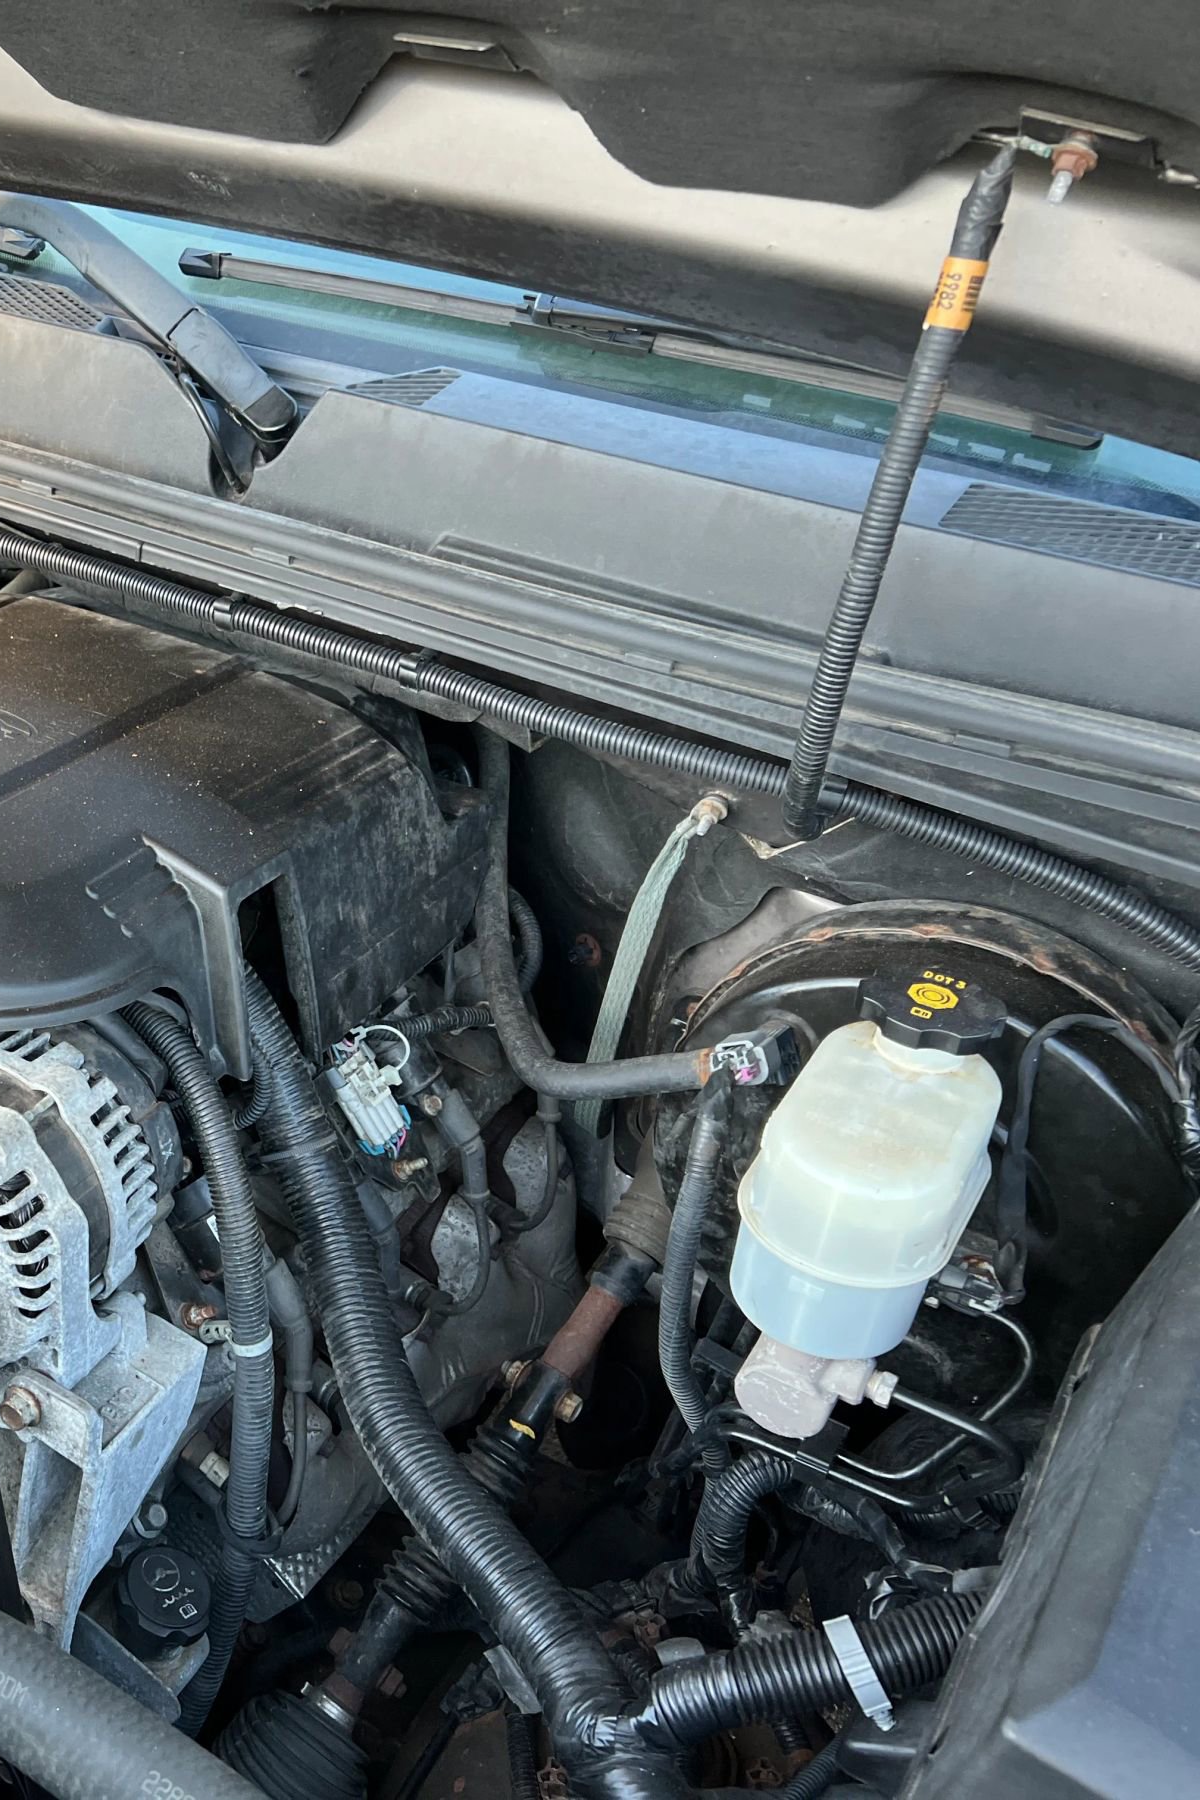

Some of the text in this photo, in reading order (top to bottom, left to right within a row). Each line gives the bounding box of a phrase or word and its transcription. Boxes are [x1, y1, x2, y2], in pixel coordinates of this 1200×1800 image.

[923, 970, 968, 990] DOT 3
[141, 1770, 196, 1800] 228
